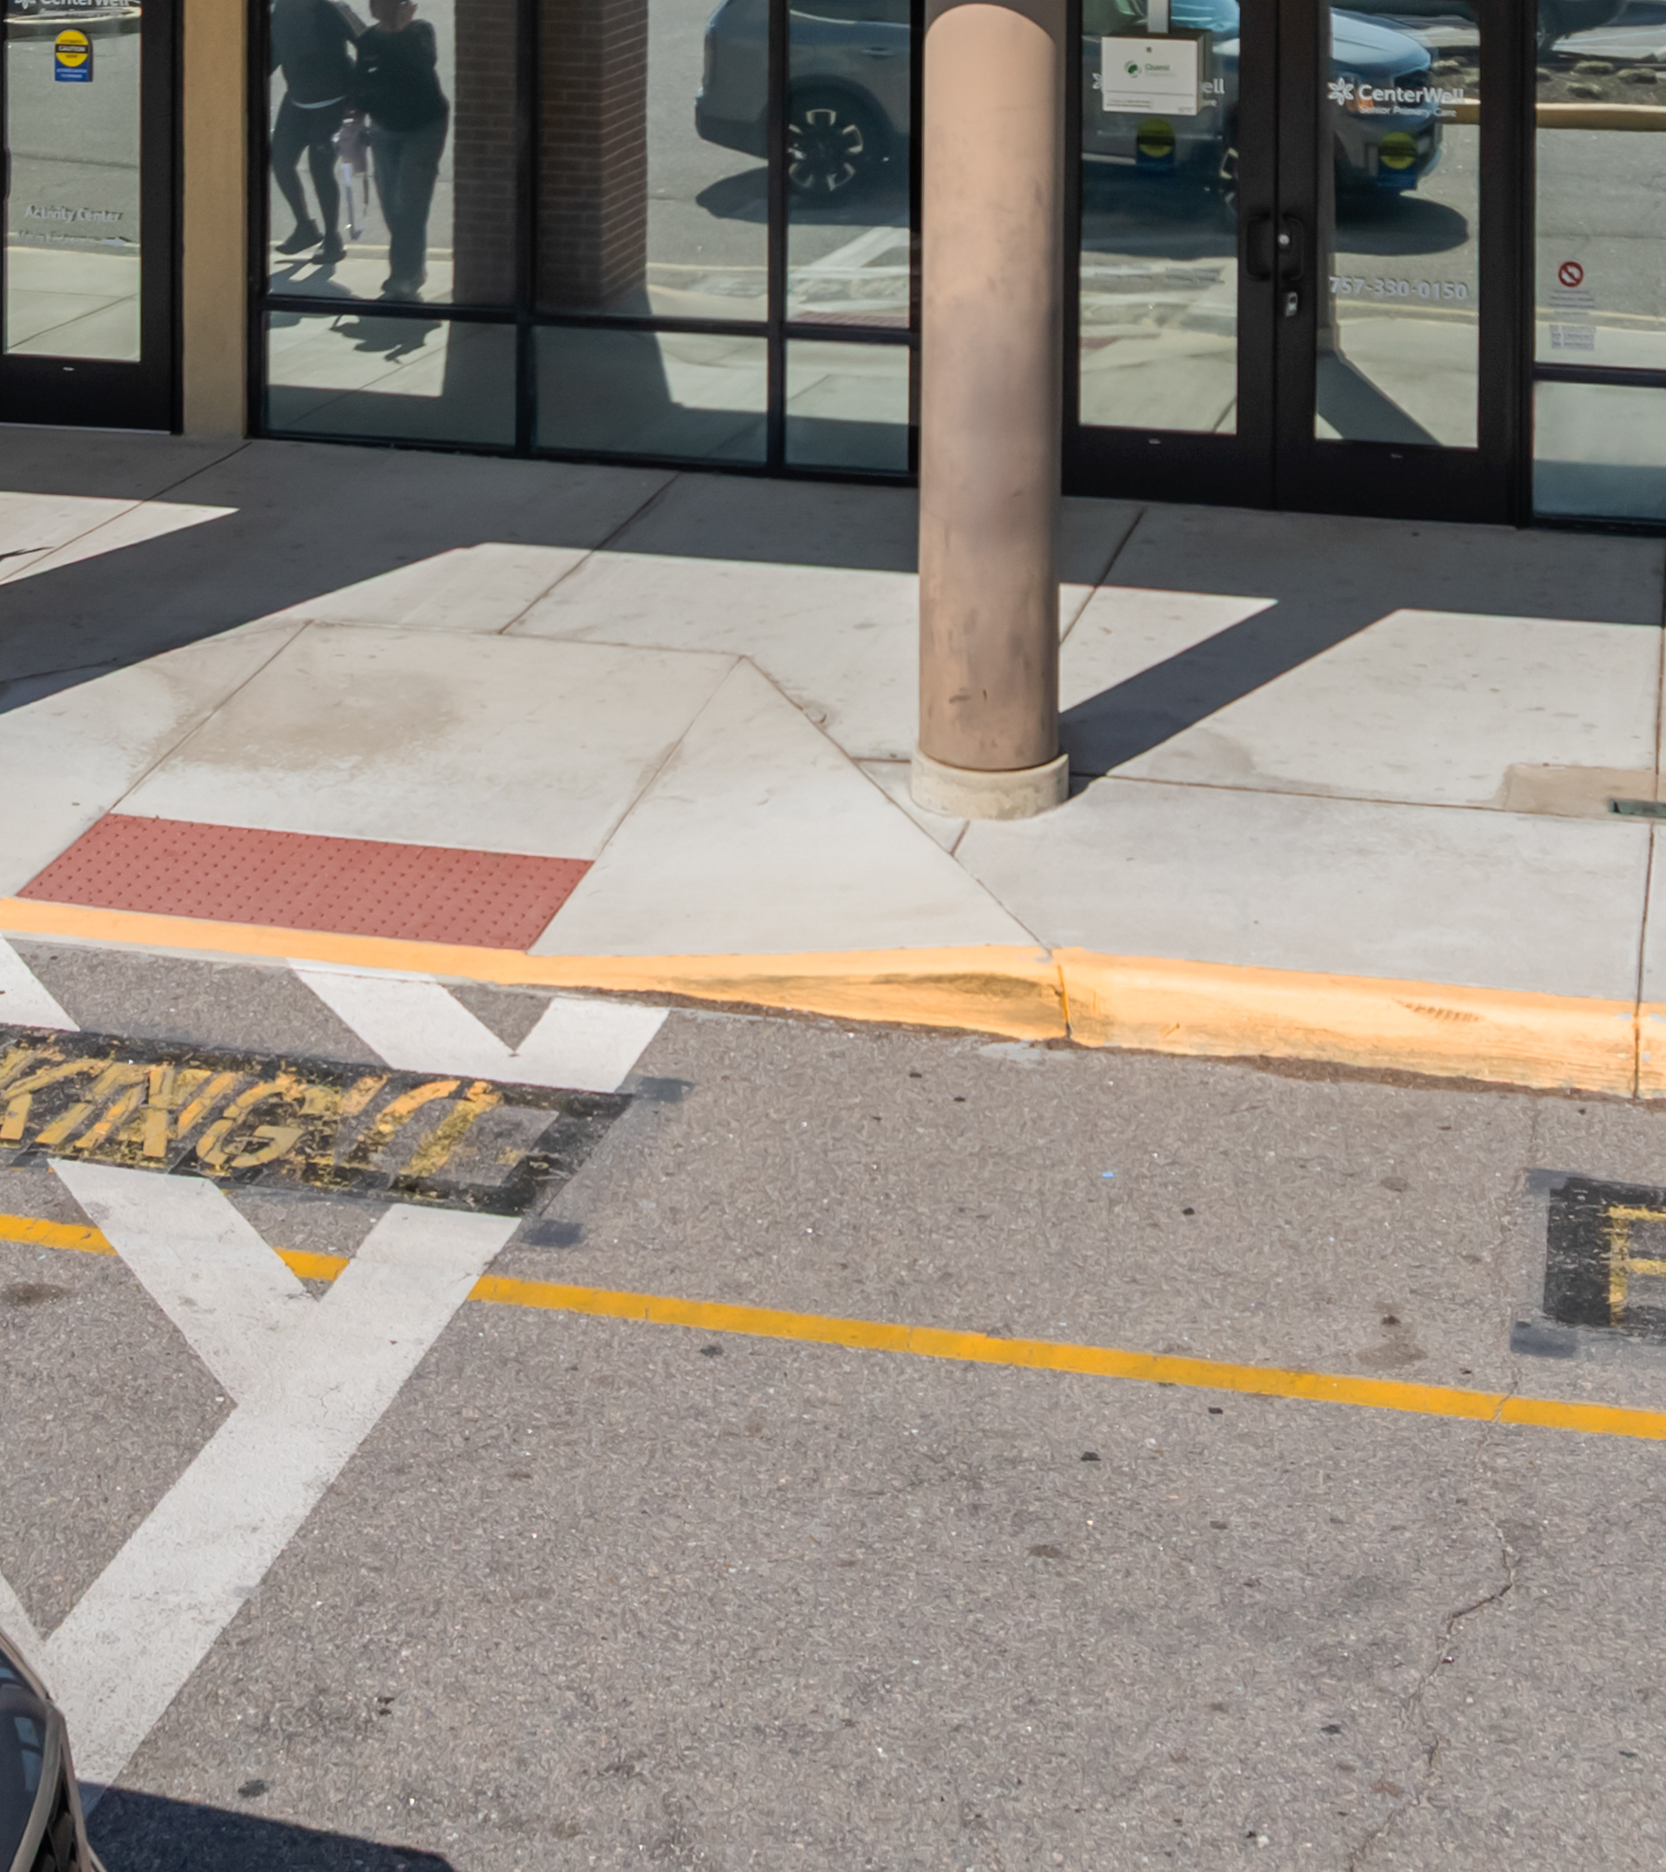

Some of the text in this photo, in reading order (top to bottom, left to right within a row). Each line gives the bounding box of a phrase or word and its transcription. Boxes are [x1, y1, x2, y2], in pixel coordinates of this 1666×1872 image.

[1358, 84, 1464, 104] CenterWell
[1393, 106, 1431, 119] Primary
[1434, 108, 1458, 118] Care
[24, 206, 123, 224] Activity Center
